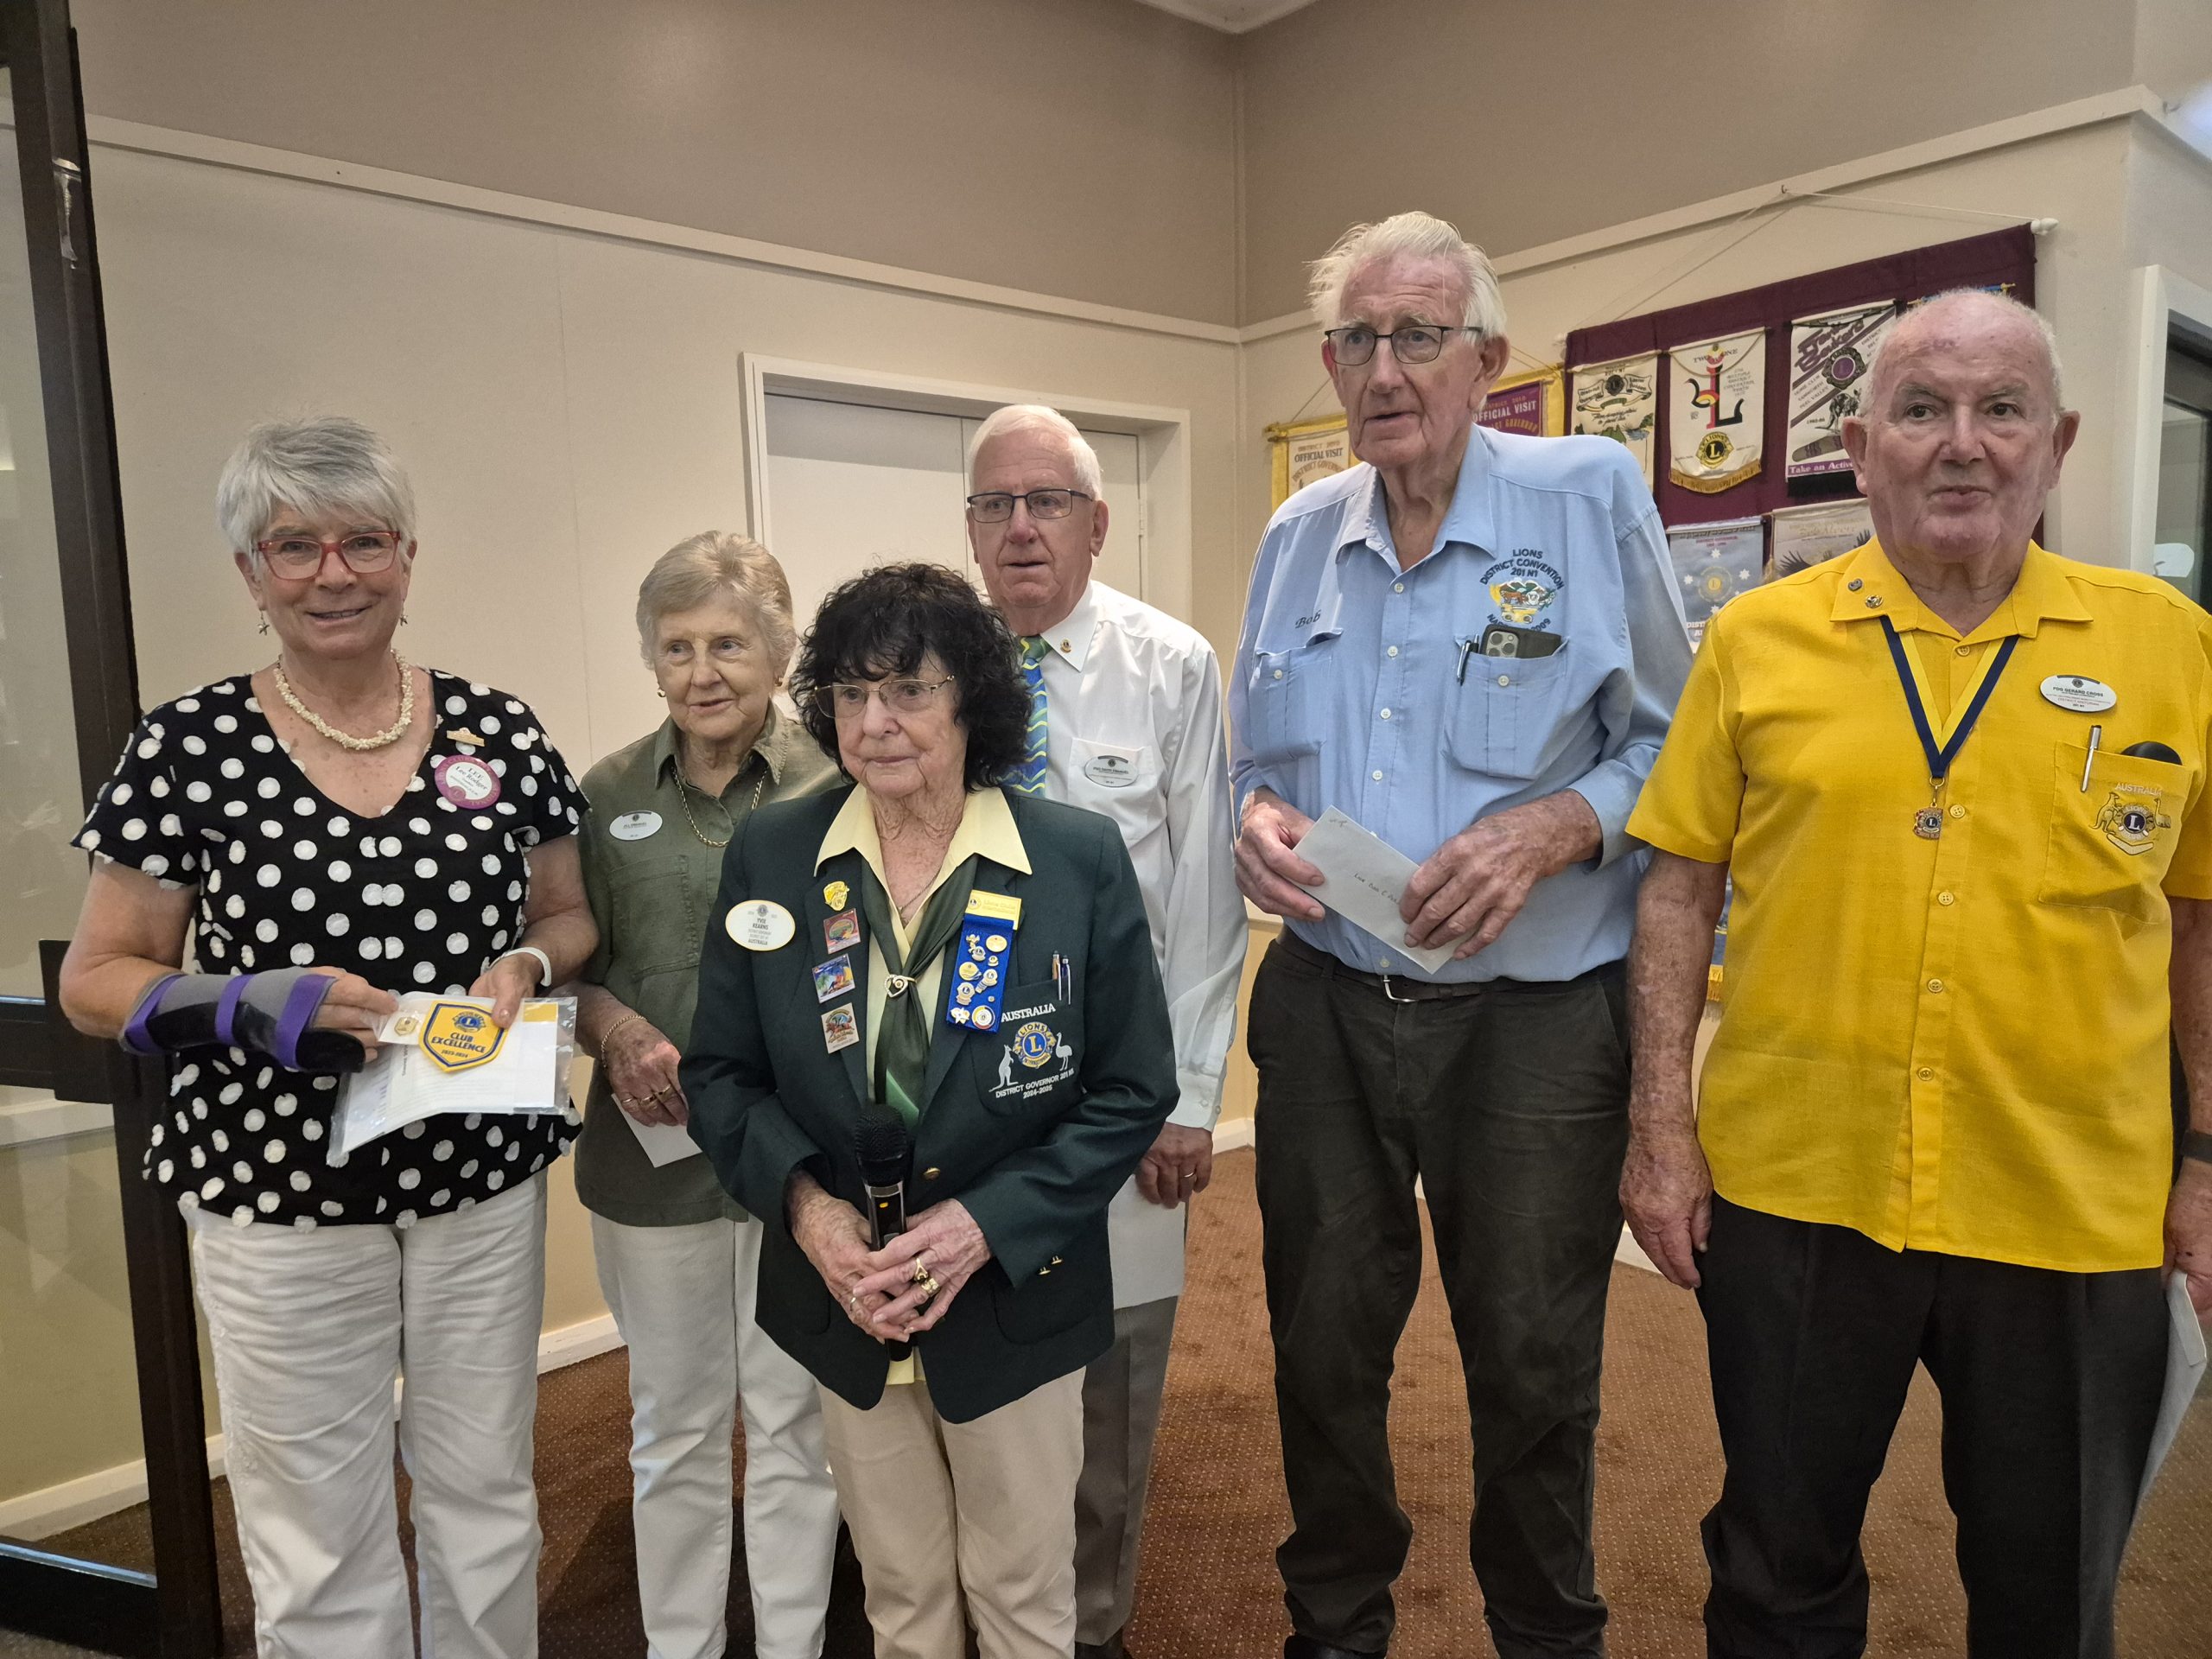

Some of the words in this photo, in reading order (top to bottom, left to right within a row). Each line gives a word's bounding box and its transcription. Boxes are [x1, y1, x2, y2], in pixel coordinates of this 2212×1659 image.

[1472, 407, 1511, 423] OFFICIAL
[1514, 401, 1536, 414] VISIT
[1294, 449, 1325, 463] OFFICIAL
[1325, 448, 1344, 458] VISIT
[1709, 443, 1720, 458] L
[1789, 465, 1811, 474] Take
[1512, 549, 1543, 559] LIONS
[1479, 559, 1514, 585] DISTRICT
[1510, 568, 1526, 576] 201
[1516, 558, 1565, 589] CONVENTION
[1295, 609, 1321, 629] Bob
[456, 766, 467, 775] Lee
[467, 774, 487, 790] Rodger
[2114, 783, 2164, 796] AUSTRALIA
[2128, 815, 2140, 830] L
[1001, 1002, 1056, 1022] AUSTRALIA
[466, 1017, 474, 1027] L
[1020, 1023, 1046, 1035] LIONS
[432, 1036, 486, 1053] EXCELLENCE
[449, 1032, 474, 1042] CLUB
[1028, 1035, 1042, 1053] L
[995, 1084, 1024, 1098] DISTRICT
[1026, 1075, 1059, 1090] GOVERNOR
[1023, 1084, 1052, 1099] 2024-2025
